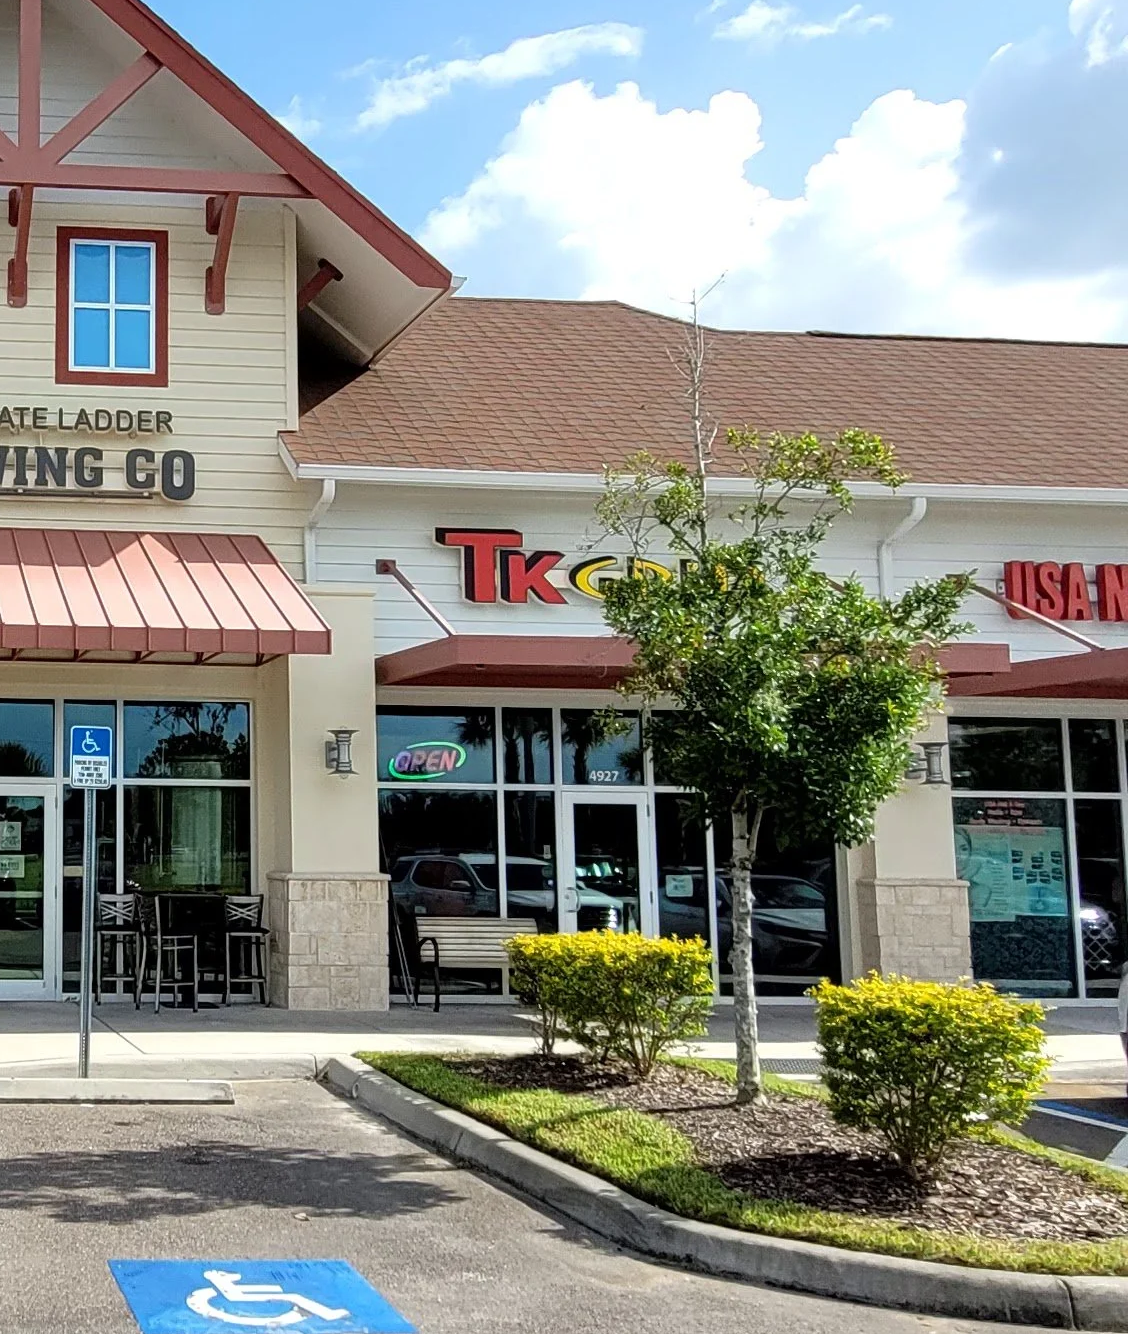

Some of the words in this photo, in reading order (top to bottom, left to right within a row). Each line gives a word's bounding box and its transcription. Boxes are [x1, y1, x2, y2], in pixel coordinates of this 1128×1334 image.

[58, 407, 174, 434] LADDER
[125, 448, 196, 501] CO
[1004, 560, 1093, 621] USA
[395, 749, 457, 772] OPEN
[589, 770, 619, 782] 4927
